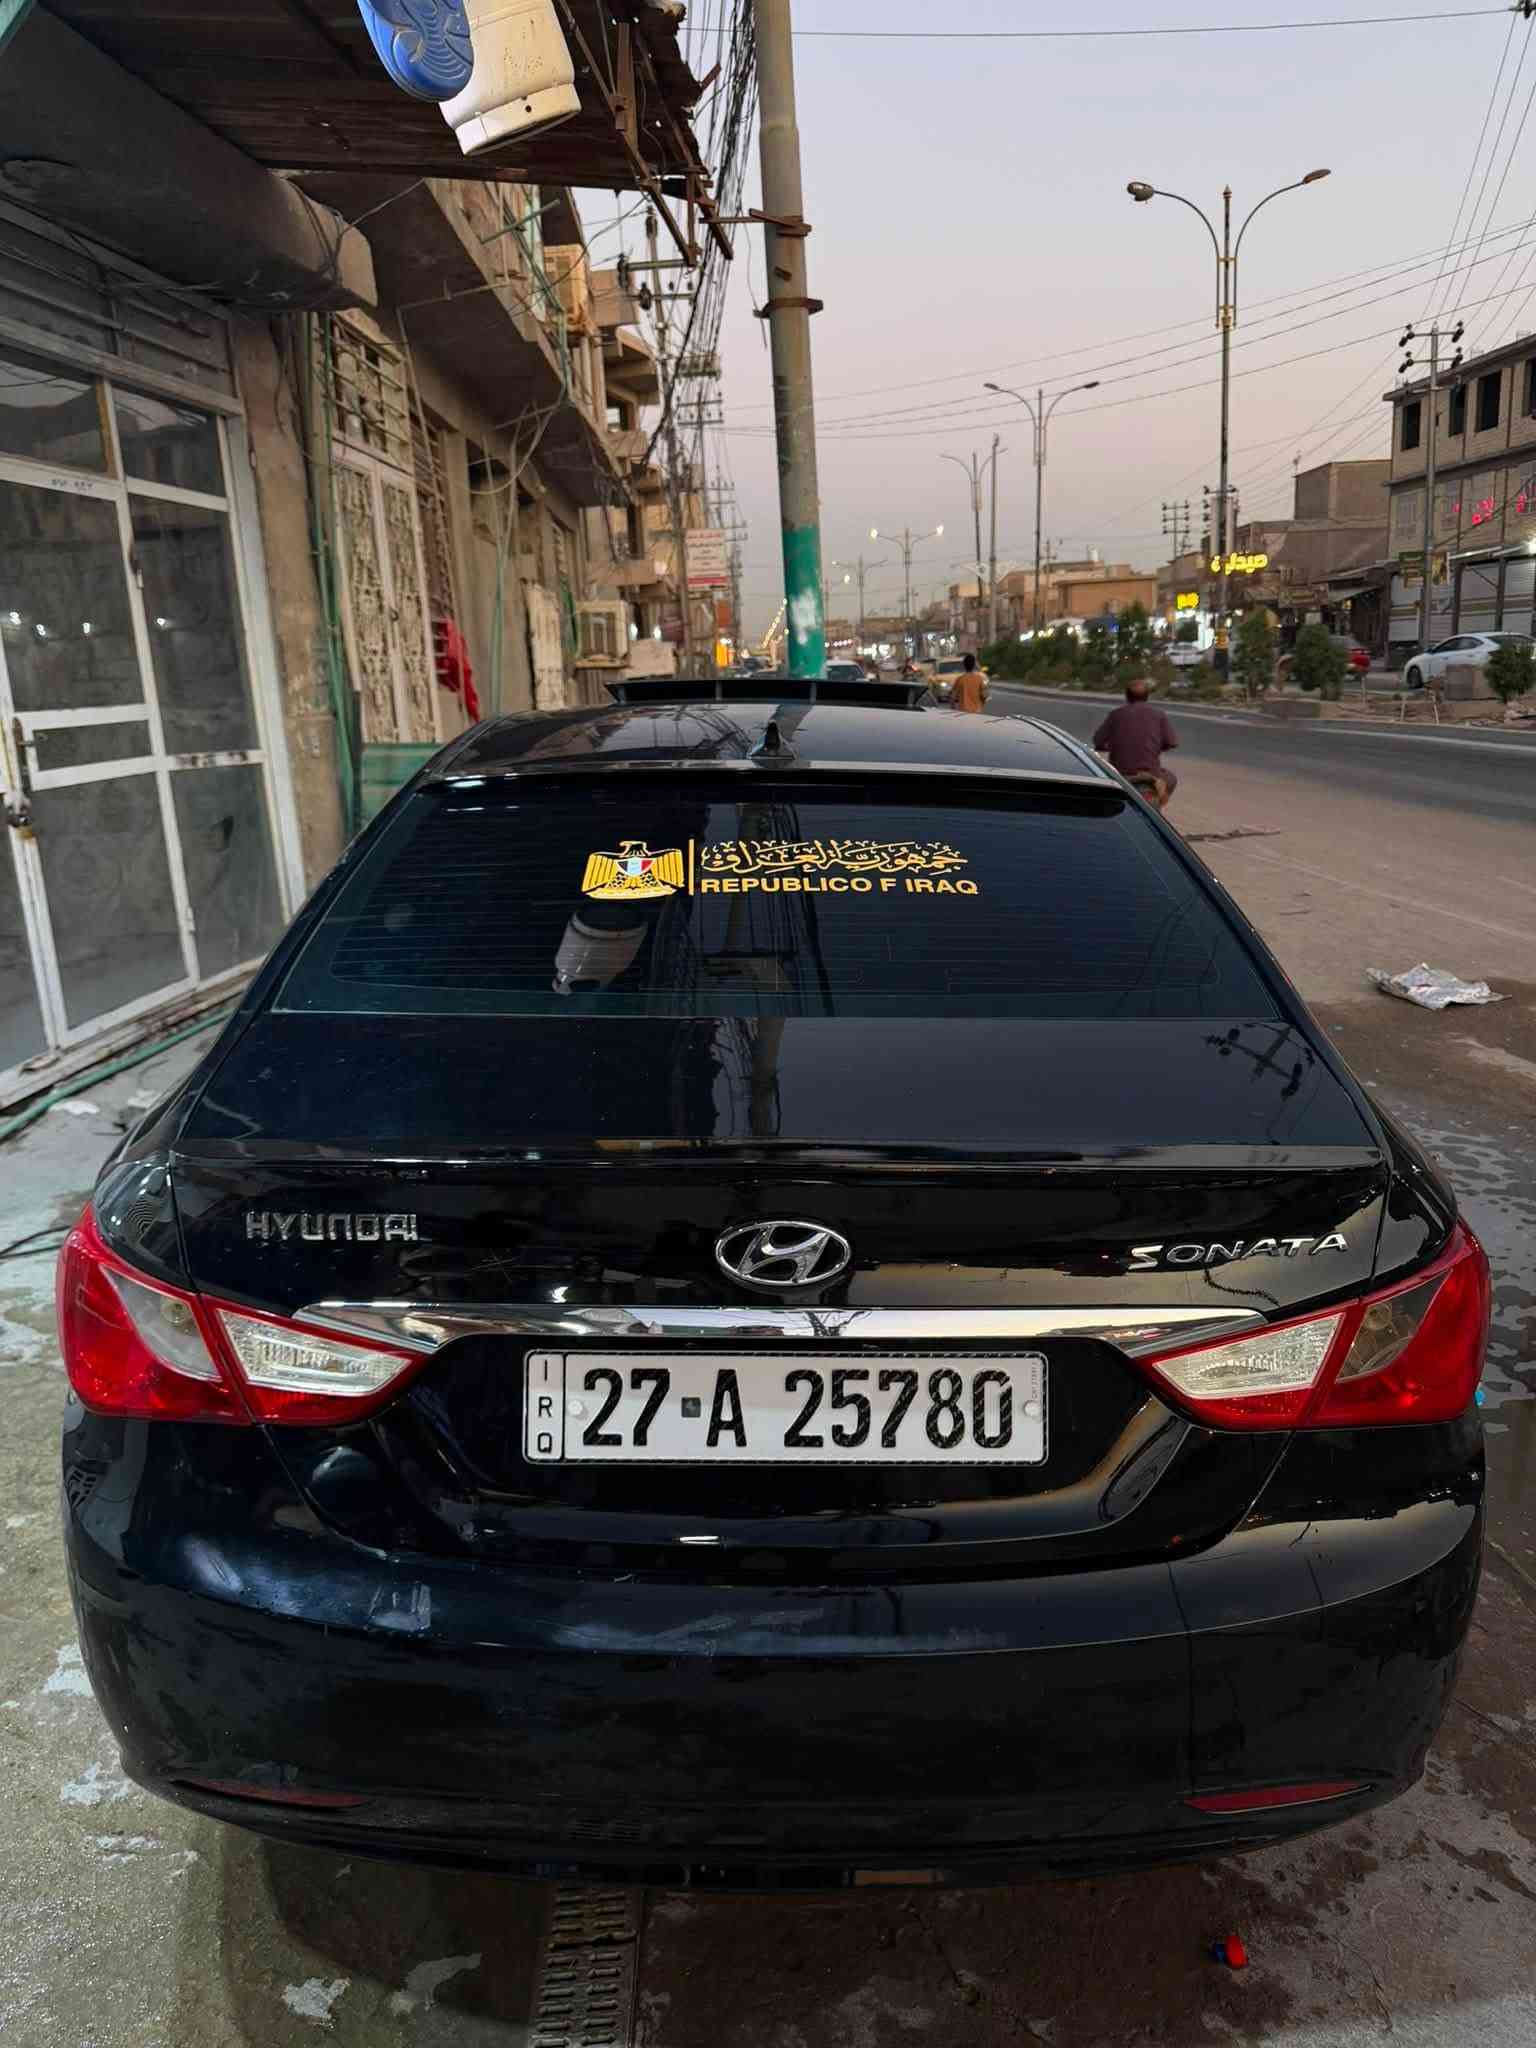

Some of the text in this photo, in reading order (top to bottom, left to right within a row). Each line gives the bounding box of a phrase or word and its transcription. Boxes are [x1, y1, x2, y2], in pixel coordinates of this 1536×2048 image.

[701, 878, 872, 893] REPUBLICO
[905, 878, 979, 895] IRAQ
[245, 1211, 418, 1241] HYUNDAI
[1128, 1233, 1349, 1271] SONATA
[582, 1368, 671, 1447] 27
[706, 1368, 748, 1448] A
[783, 1368, 1013, 1449] 25780
